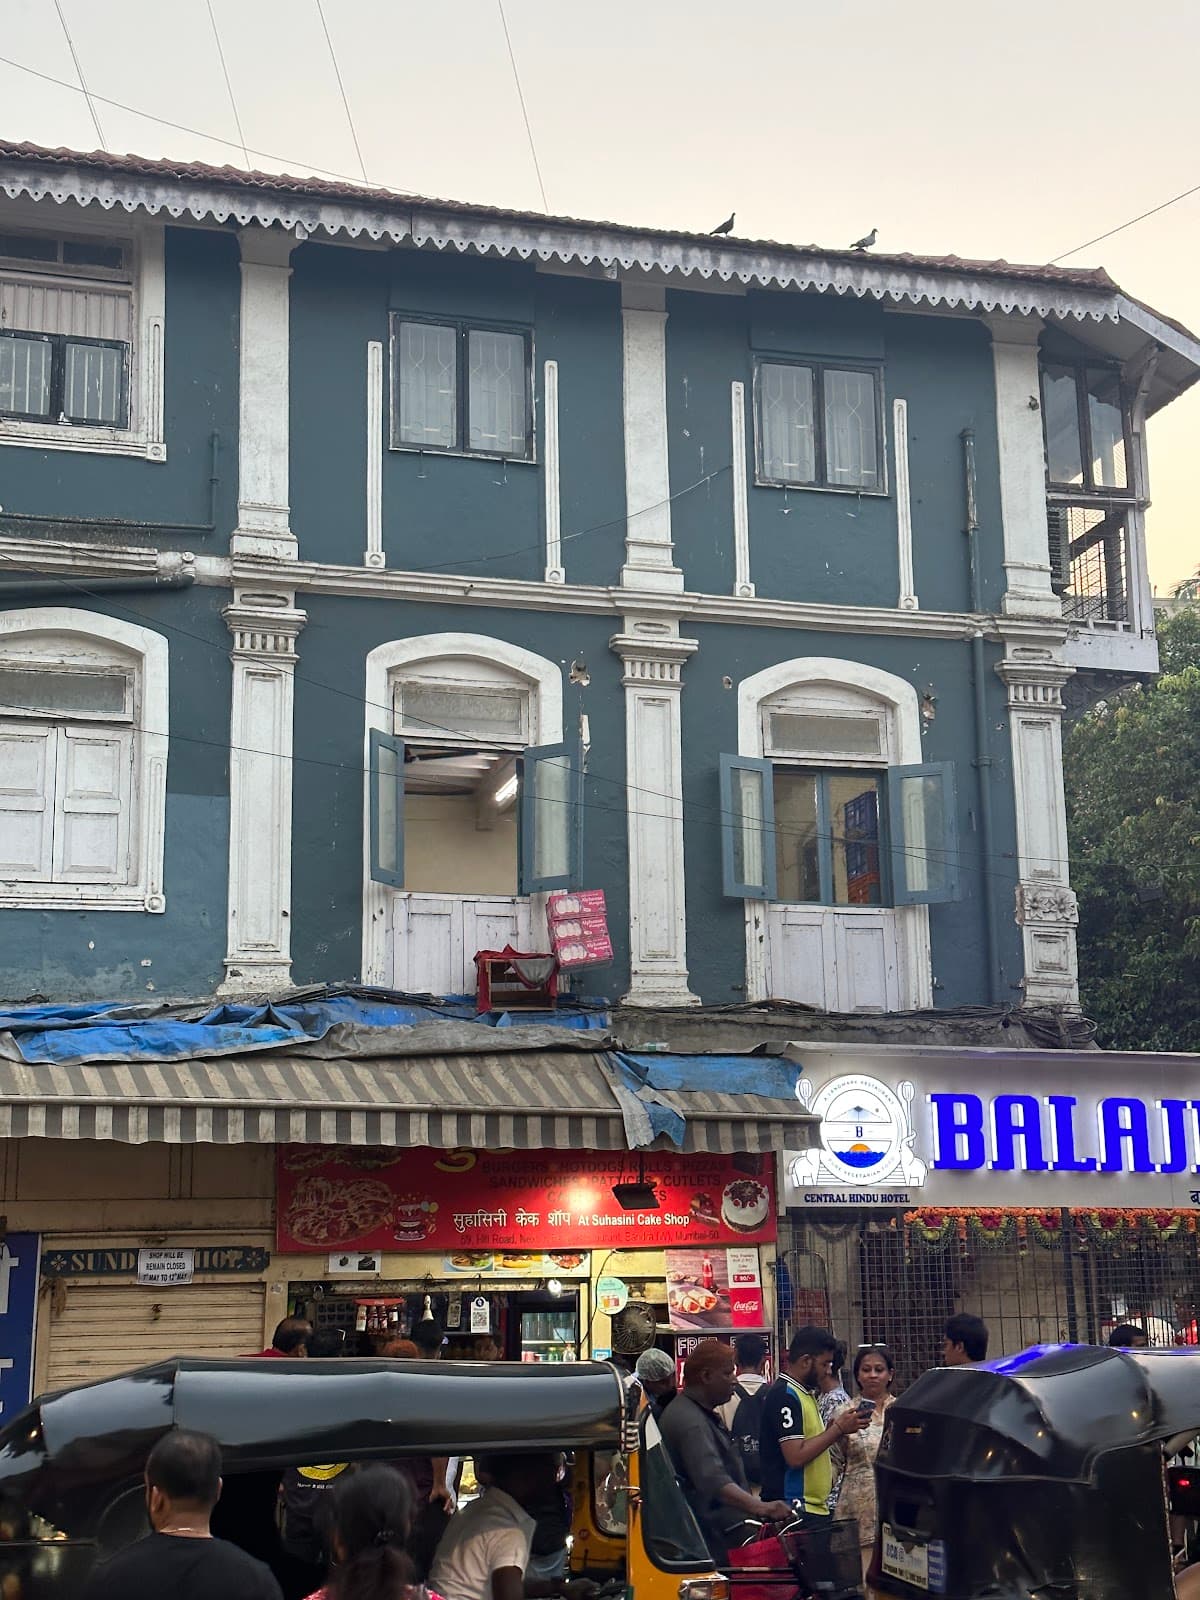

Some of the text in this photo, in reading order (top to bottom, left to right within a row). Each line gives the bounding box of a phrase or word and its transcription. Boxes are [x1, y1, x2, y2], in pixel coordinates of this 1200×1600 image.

[926, 1093, 1200, 1173] BALAJ
[663, 1175, 720, 1187] CUTLETS
[804, 1194, 910, 1203] CENTRAL HINDU HOTEL
[453, 1208, 571, 1233] सुहासिनी केक शॉप
[578, 1213, 690, 1227] At Suhasini Cake Shop
[781, 1406, 793, 1428] 3
